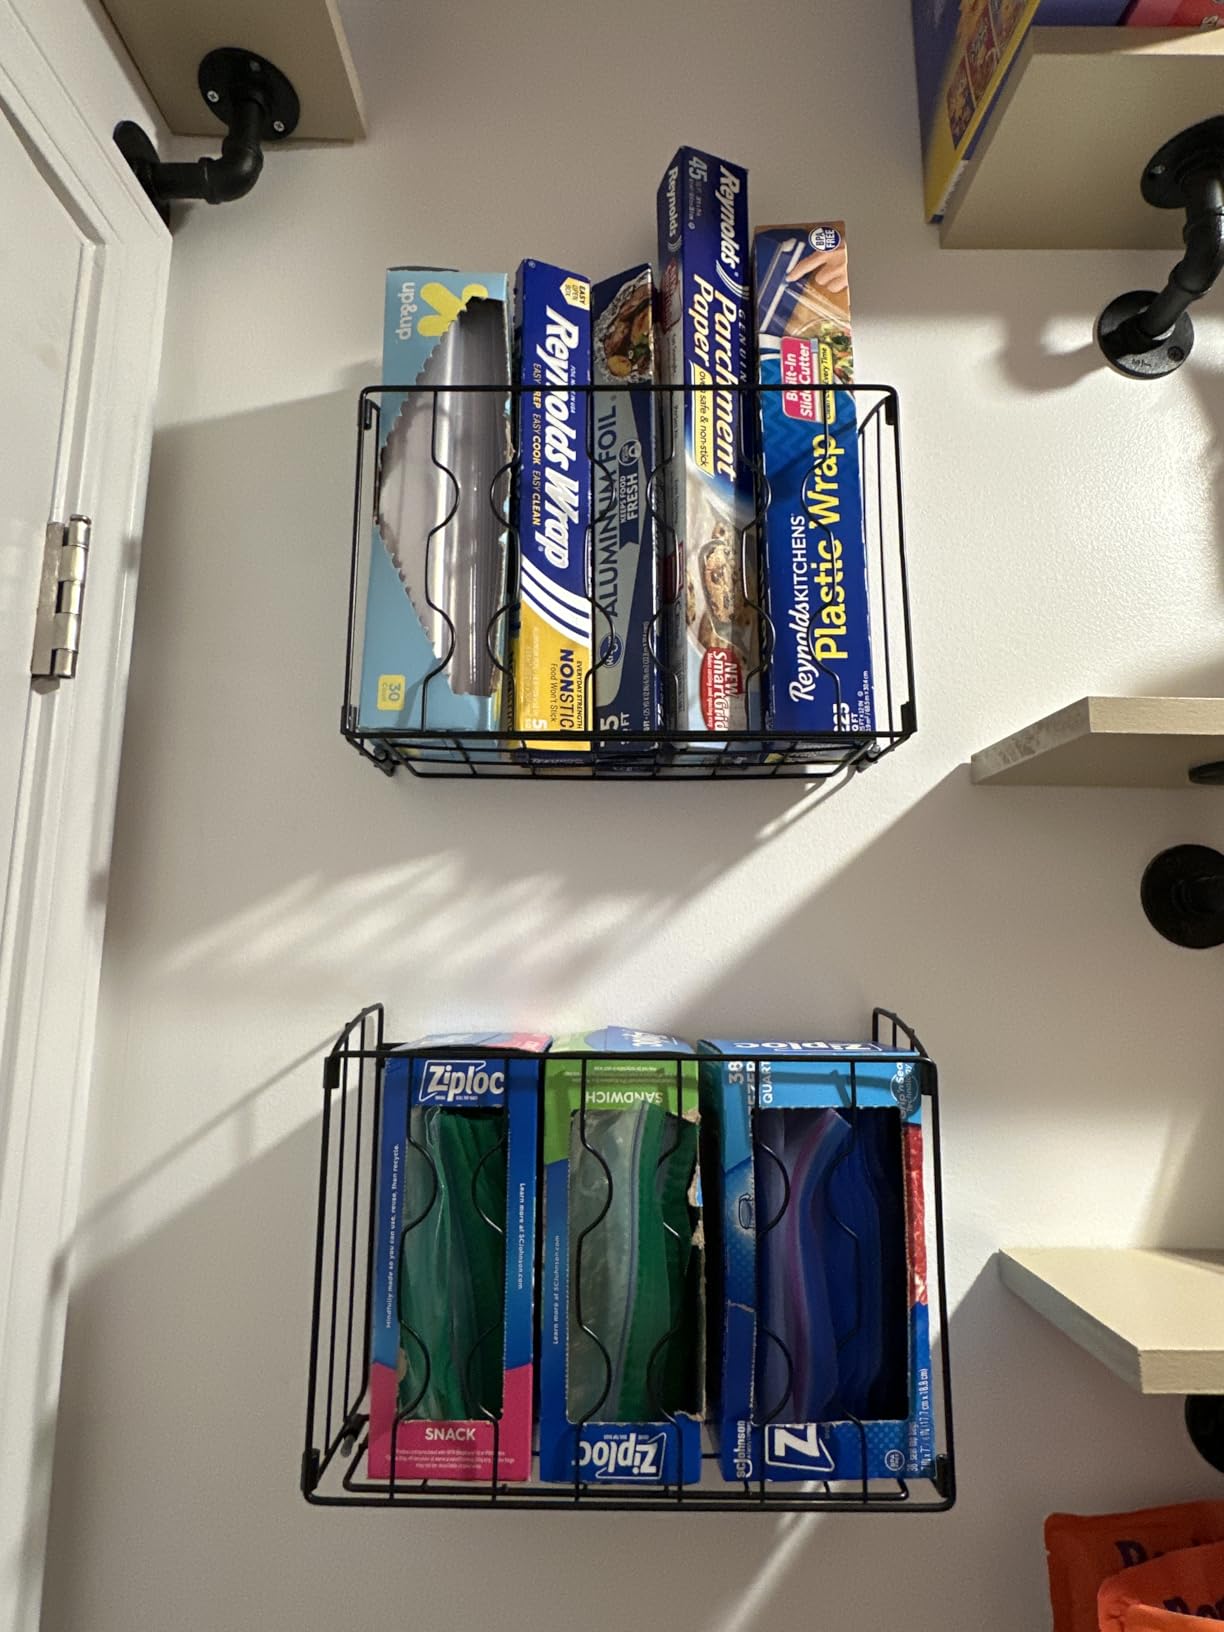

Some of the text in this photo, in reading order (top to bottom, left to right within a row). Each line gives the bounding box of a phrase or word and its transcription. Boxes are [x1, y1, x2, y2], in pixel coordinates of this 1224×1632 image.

[688, 156, 707, 181] 45
[666, 166, 678, 237] Reynolds
[715, 165, 740, 269] Reynolds
[815, 232, 824, 246] BPA
[826, 229, 835, 248] FREE
[397, 281, 417, 340] up&up
[687, 274, 714, 368] Paper
[738, 309, 747, 382] GENUIN
[714, 291, 739, 482] Parchment
[799, 343, 812, 417] Slid Cutter
[700, 395, 710, 413] safe
[532, 363, 541, 525] EASY REP EASY COOK EASY CLEAN
[535, 306, 579, 569] Reynolds Wrap
[598, 405, 616, 463] FOIL
[700, 425, 708, 467] non-stick
[627, 473, 638, 520] FRESH
[807, 434, 848, 659] Plastic Wrap
[388, 684, 401, 702] 30
[550, 663, 558, 722] Food Won't Stick
[560, 649, 574, 730] NONSTIC
[713, 651, 728, 731] SmartGrid
[725, 663, 738, 697] NEW
[621, 712, 630, 725] FT
[851, 712, 858, 723] FT
[428, 1065, 504, 1102] Ziploc
[728, 1062, 744, 1084] 38
[761, 1061, 773, 1104] QUART
[896, 1062, 904, 1084] Sea
[586, 1091, 663, 1103] SANDWICH
[519, 1225, 525, 1233] at
[389, 1261, 394, 1269] so
[425, 1428, 476, 1440] SNACK
[579, 1433, 657, 1473] Ziploc
